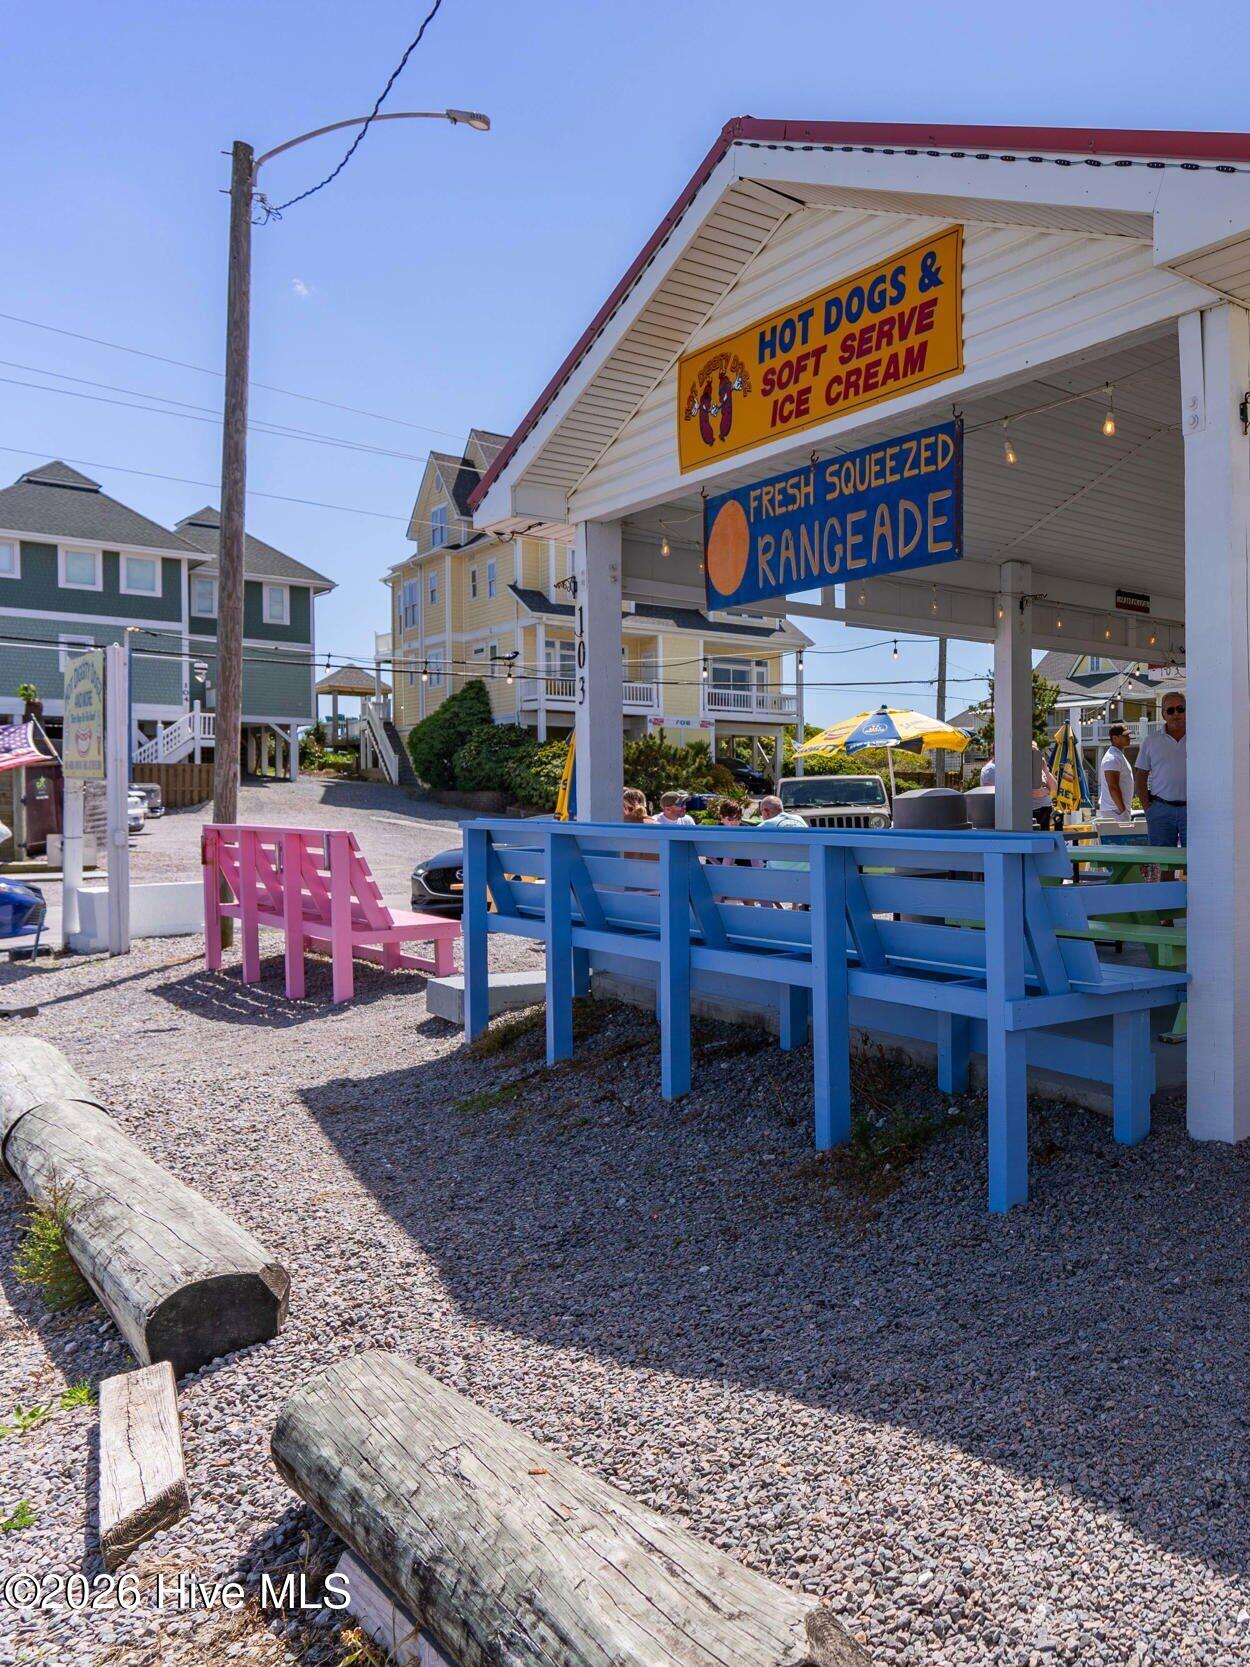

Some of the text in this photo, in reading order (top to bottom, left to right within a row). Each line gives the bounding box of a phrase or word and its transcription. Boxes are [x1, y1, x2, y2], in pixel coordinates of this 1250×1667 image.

[758, 251, 944, 364] HOT DOGS &
[760, 344, 827, 398] SOFT
[838, 297, 938, 365] SERVE
[770, 386, 812, 428] ICE
[825, 340, 928, 406] CREAM
[750, 433, 954, 523] FRESH SQUEEZED
[758, 489, 953, 589] RANGEADE
[575, 606, 585, 705] 103
